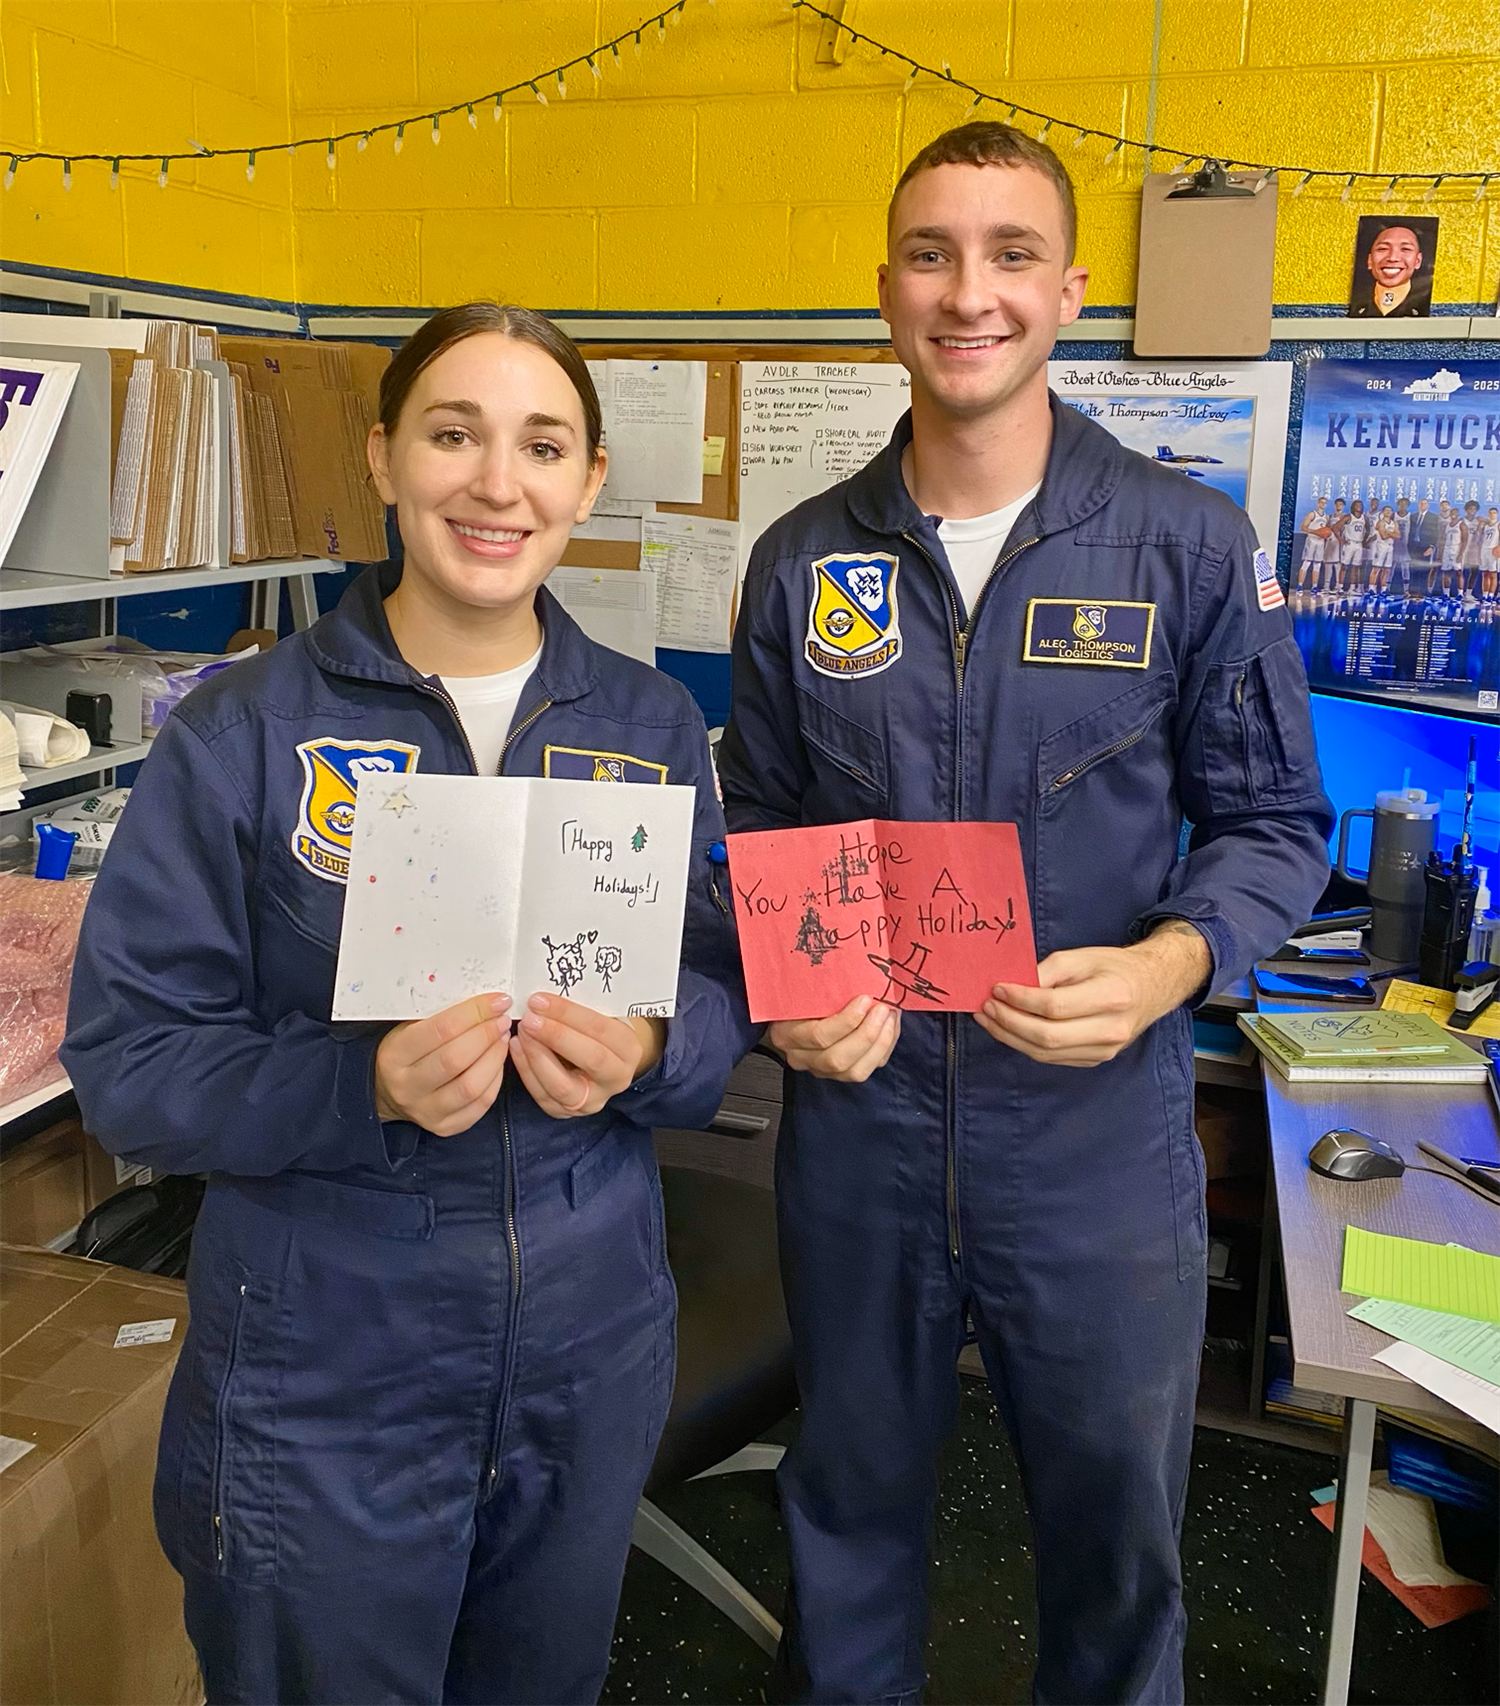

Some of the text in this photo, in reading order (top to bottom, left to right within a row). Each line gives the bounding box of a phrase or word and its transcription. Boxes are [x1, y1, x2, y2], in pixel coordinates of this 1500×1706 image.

[762, 365, 858, 377] AVDLR TRACKER
[789, 387, 820, 395] TRACKER
[824, 384, 872, 399] (WEDNESDAY)
[1366, 380, 1392, 390] 2024
[1473, 380, 1500, 391] 2025
[1326, 412, 1500, 451] KENTUCK
[750, 444, 802, 453] SIGN WORKSHEET
[749, 456, 766, 464] WORK
[1369, 456, 1485, 469] BASKETBALL
[1389, 613, 1418, 621] POPE
[1452, 616, 1494, 624] BEGINS
[1039, 639, 1136, 654] ALEC THOMPSON
[816, 650, 885, 670] BLUE ANGELS
[1059, 649, 1114, 660] LOGISTICS
[839, 832, 913, 871] Hope
[313, 852, 350, 874] BLUE
[736, 868, 969, 916] You Have A
[803, 897, 1017, 947] Happy Holiday!
[1287, 1019, 1322, 1042] NOTES
